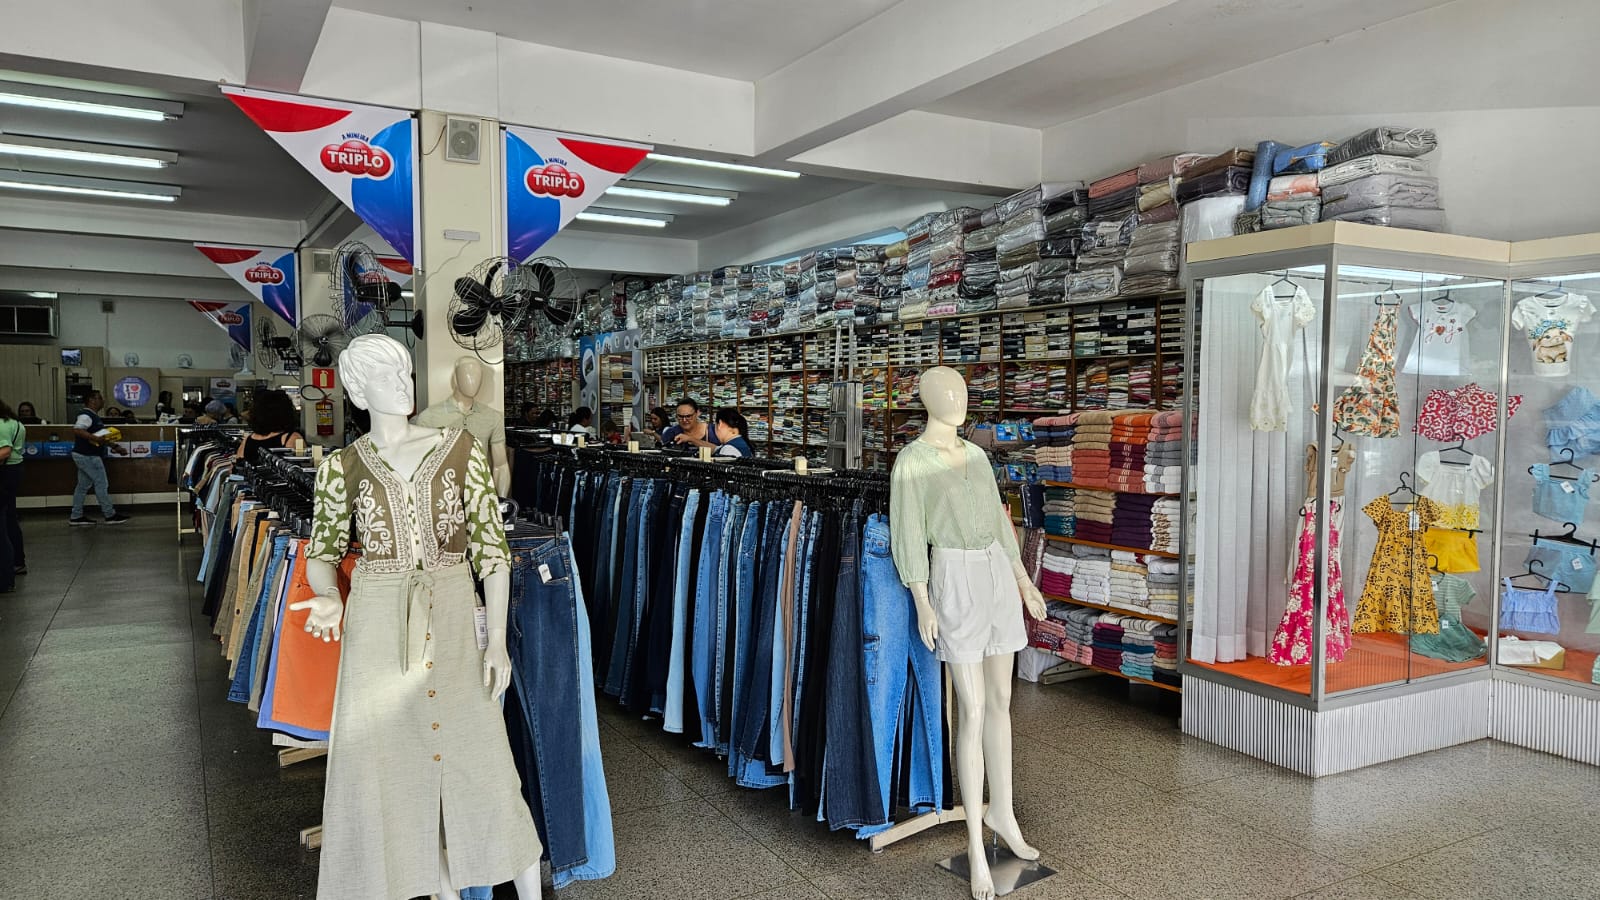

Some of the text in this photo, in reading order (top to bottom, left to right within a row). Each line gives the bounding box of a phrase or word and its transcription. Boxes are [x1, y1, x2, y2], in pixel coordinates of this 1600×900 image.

[327, 150, 384, 168] TRIPLO
[533, 173, 579, 190] TRIPLO
[248, 271, 279, 280] TRIPLO
